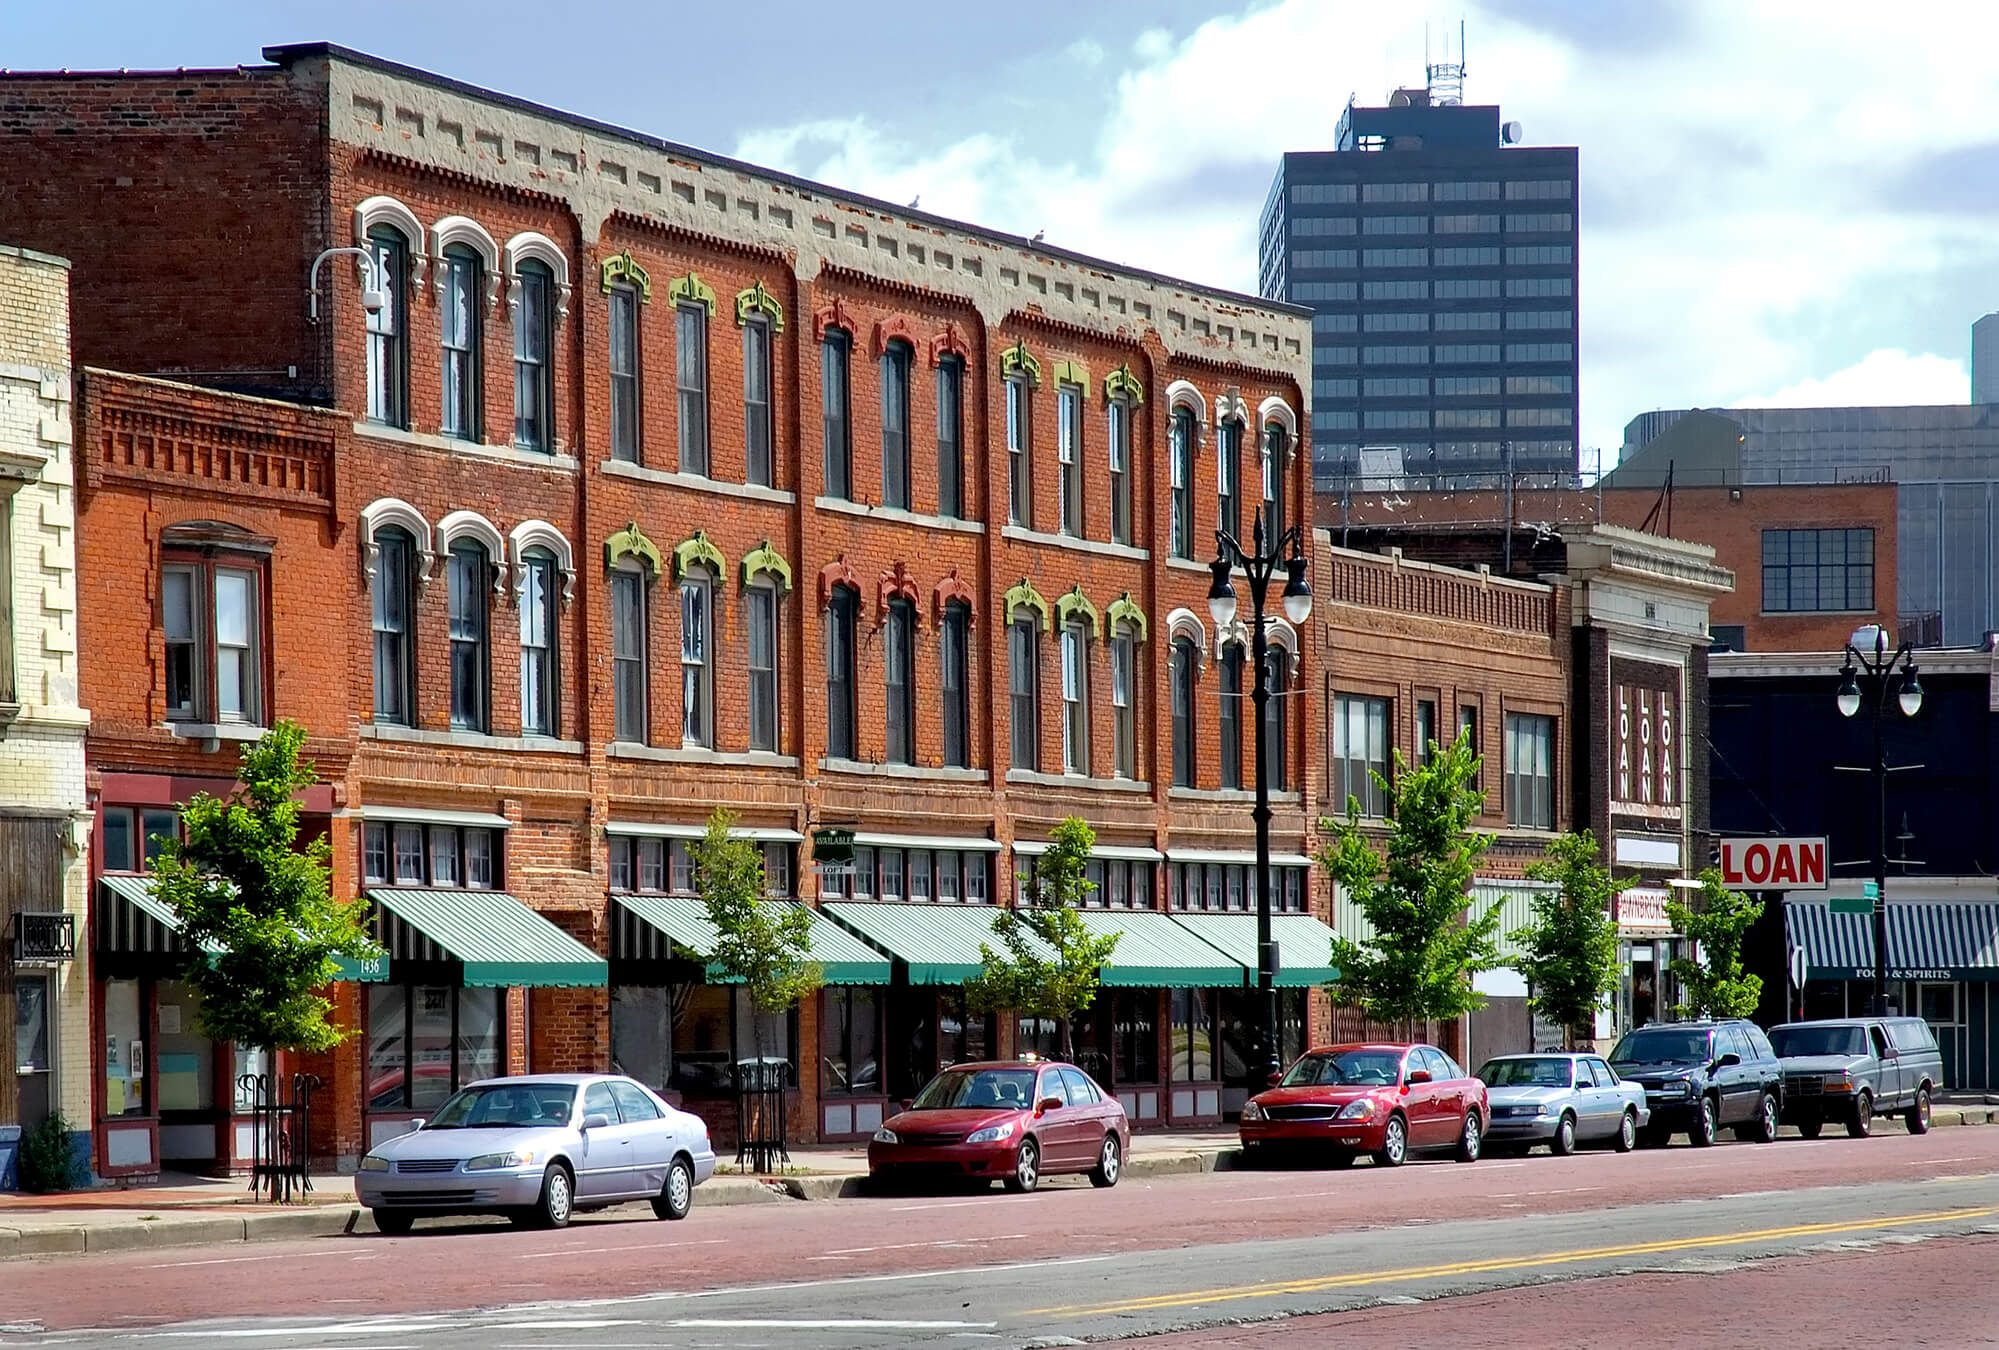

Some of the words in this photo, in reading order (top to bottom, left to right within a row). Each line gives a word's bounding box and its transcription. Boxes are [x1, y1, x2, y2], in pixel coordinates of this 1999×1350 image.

[1620, 685, 1628, 799] LOAN
[1641, 688, 1650, 803] LOAN
[1662, 691, 1671, 804] LOAN
[815, 836, 851, 845] AVAILABLE
[1722, 843, 1824, 884] LOAN
[1616, 893, 1669, 919] PAWNBROKE
[360, 958, 379, 973] 1436
[1892, 969, 1902, 978] &
[1905, 969, 1951, 979] SPIRITS
